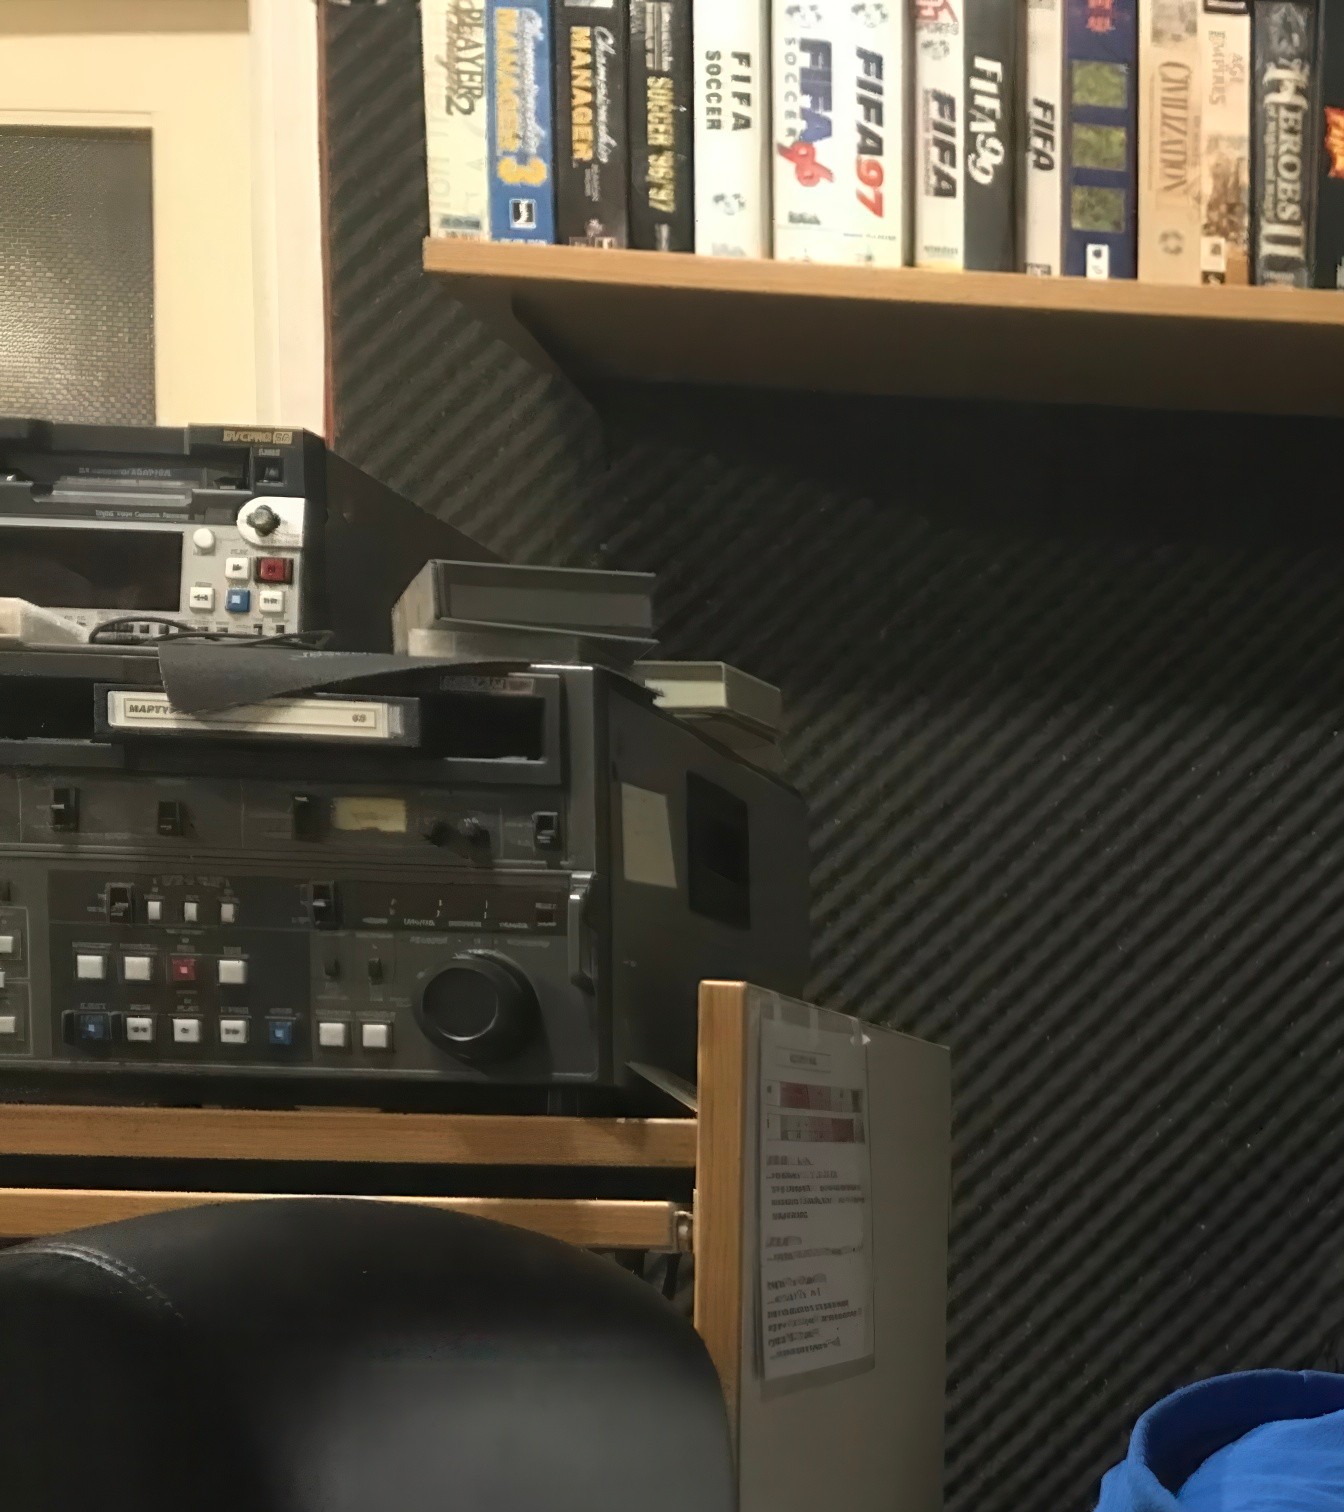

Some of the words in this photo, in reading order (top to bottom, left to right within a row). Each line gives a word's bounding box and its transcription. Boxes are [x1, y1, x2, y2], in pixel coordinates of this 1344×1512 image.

[456, 7, 484, 99] PLAYER
[569, 25, 593, 162] MANAGER
[705, 50, 722, 132] SOCCER
[729, 50, 752, 132] FIFA
[798, 38, 833, 144] FIFA
[497, 155, 548, 186] 3
[777, 140, 836, 188] 96
[931, 88, 958, 200] FIFA
[1028, 96, 1056, 172] FIFA
[1262, 58, 1309, 223] HEROES
